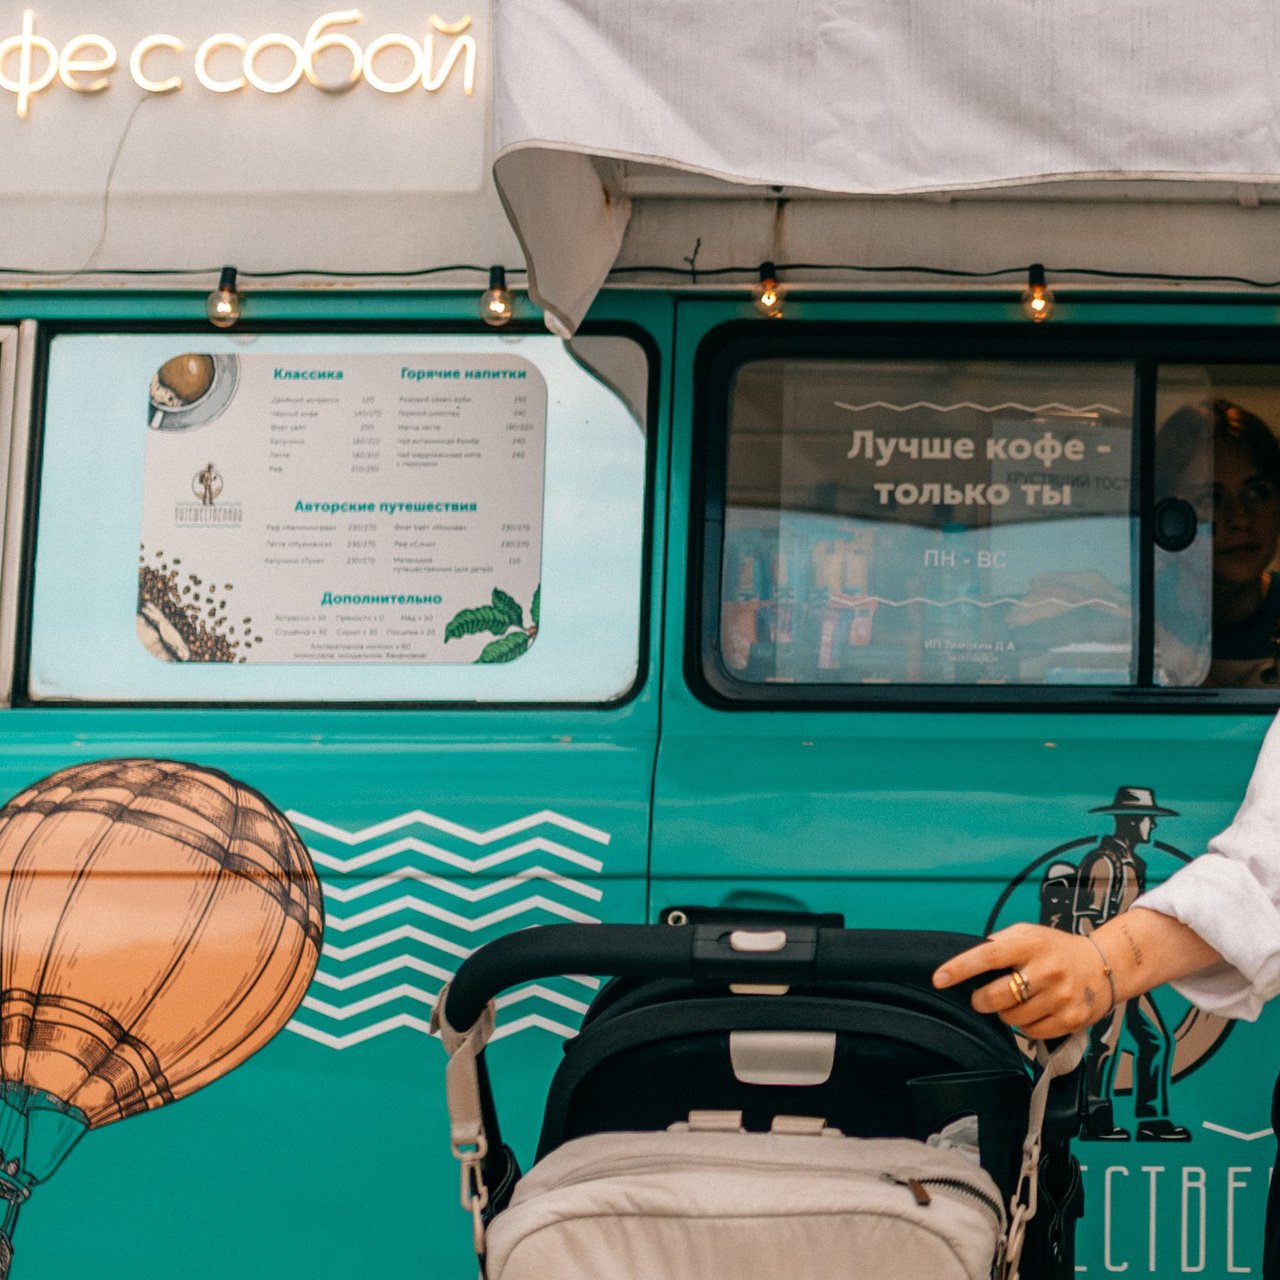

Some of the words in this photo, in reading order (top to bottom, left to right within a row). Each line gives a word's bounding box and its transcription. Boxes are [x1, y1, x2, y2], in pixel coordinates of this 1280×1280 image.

[0, 8, 118, 119] фе
[130, 32, 184, 93] с
[194, 8, 477, 95] собой
[273, 367, 344, 380] Классика
[401, 366, 461, 382] Горячие
[464, 368, 527, 380] напитки
[847, 429, 975, 467] Лучше
[986, 432, 1085, 468] кофе
[873, 483, 1011, 506] только
[1020, 483, 1072, 507] ты
[294, 500, 376, 515] Авторские
[379, 502, 477, 516] путешествия
[924, 549, 955, 567] ПН
[977, 550, 1007, 568] ВС
[321, 591, 443, 607] Дополнительно
[1075, 1165, 1274, 1273] СТВЕ
